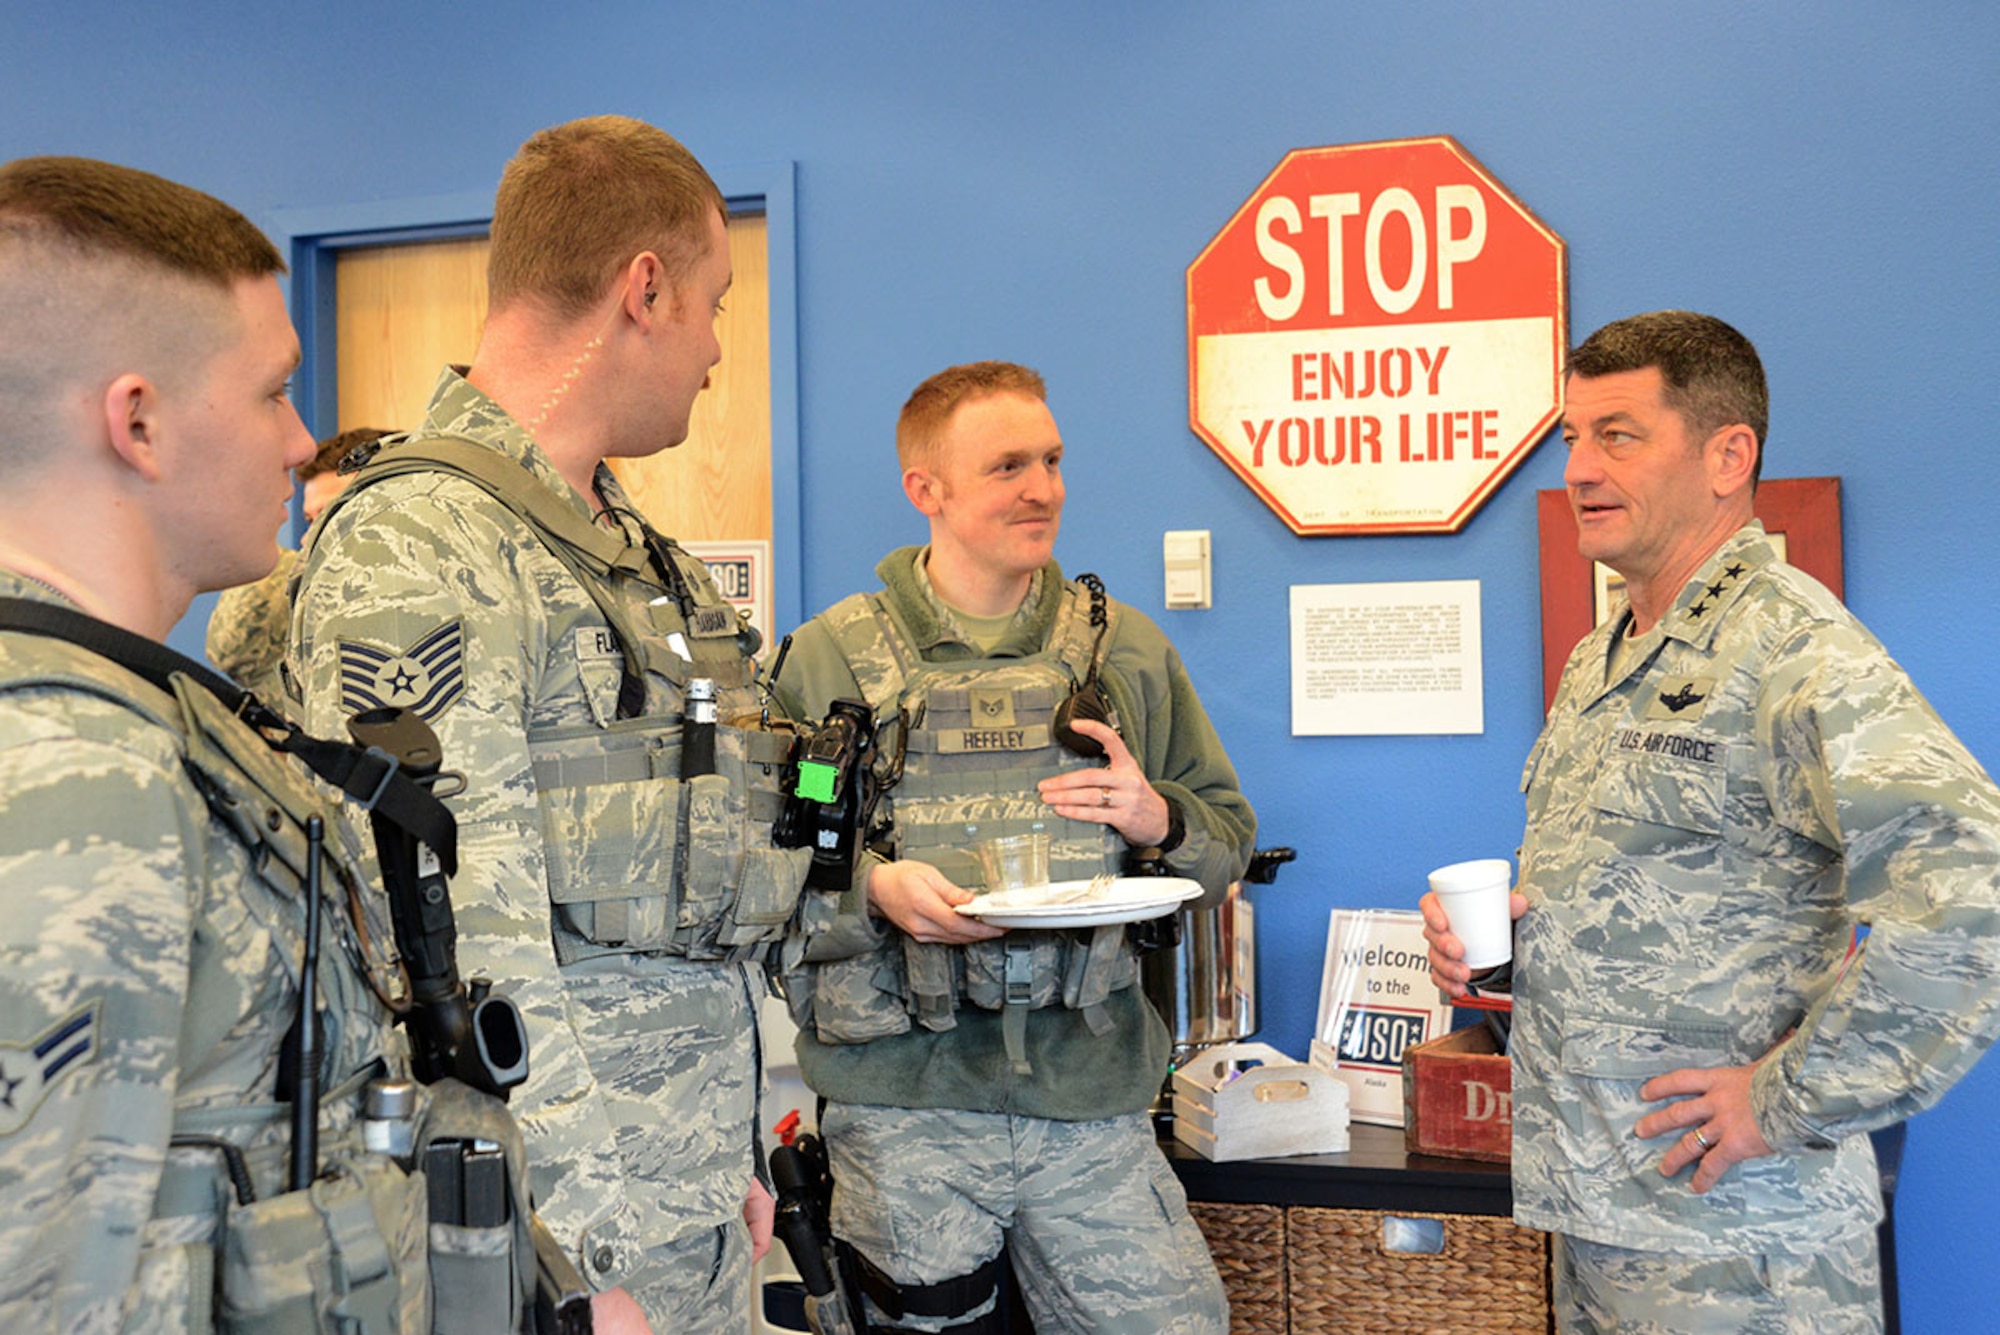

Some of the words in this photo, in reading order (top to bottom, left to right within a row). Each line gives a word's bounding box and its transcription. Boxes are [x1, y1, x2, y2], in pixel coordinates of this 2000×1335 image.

[1253, 184, 1487, 321] STOP
[1292, 346, 1450, 401] ENJOY
[1242, 416, 1382, 468] YOUR
[1400, 410, 1499, 462] LIFE
[704, 564, 738, 596] SO
[963, 731, 1024, 749] HEFFLEY
[1641, 732, 1664, 753] AIR
[1662, 735, 1715, 763] FORCE
[1341, 944, 1432, 974] Welcom
[1367, 979, 1382, 993] to
[1386, 979, 1411, 995] the
